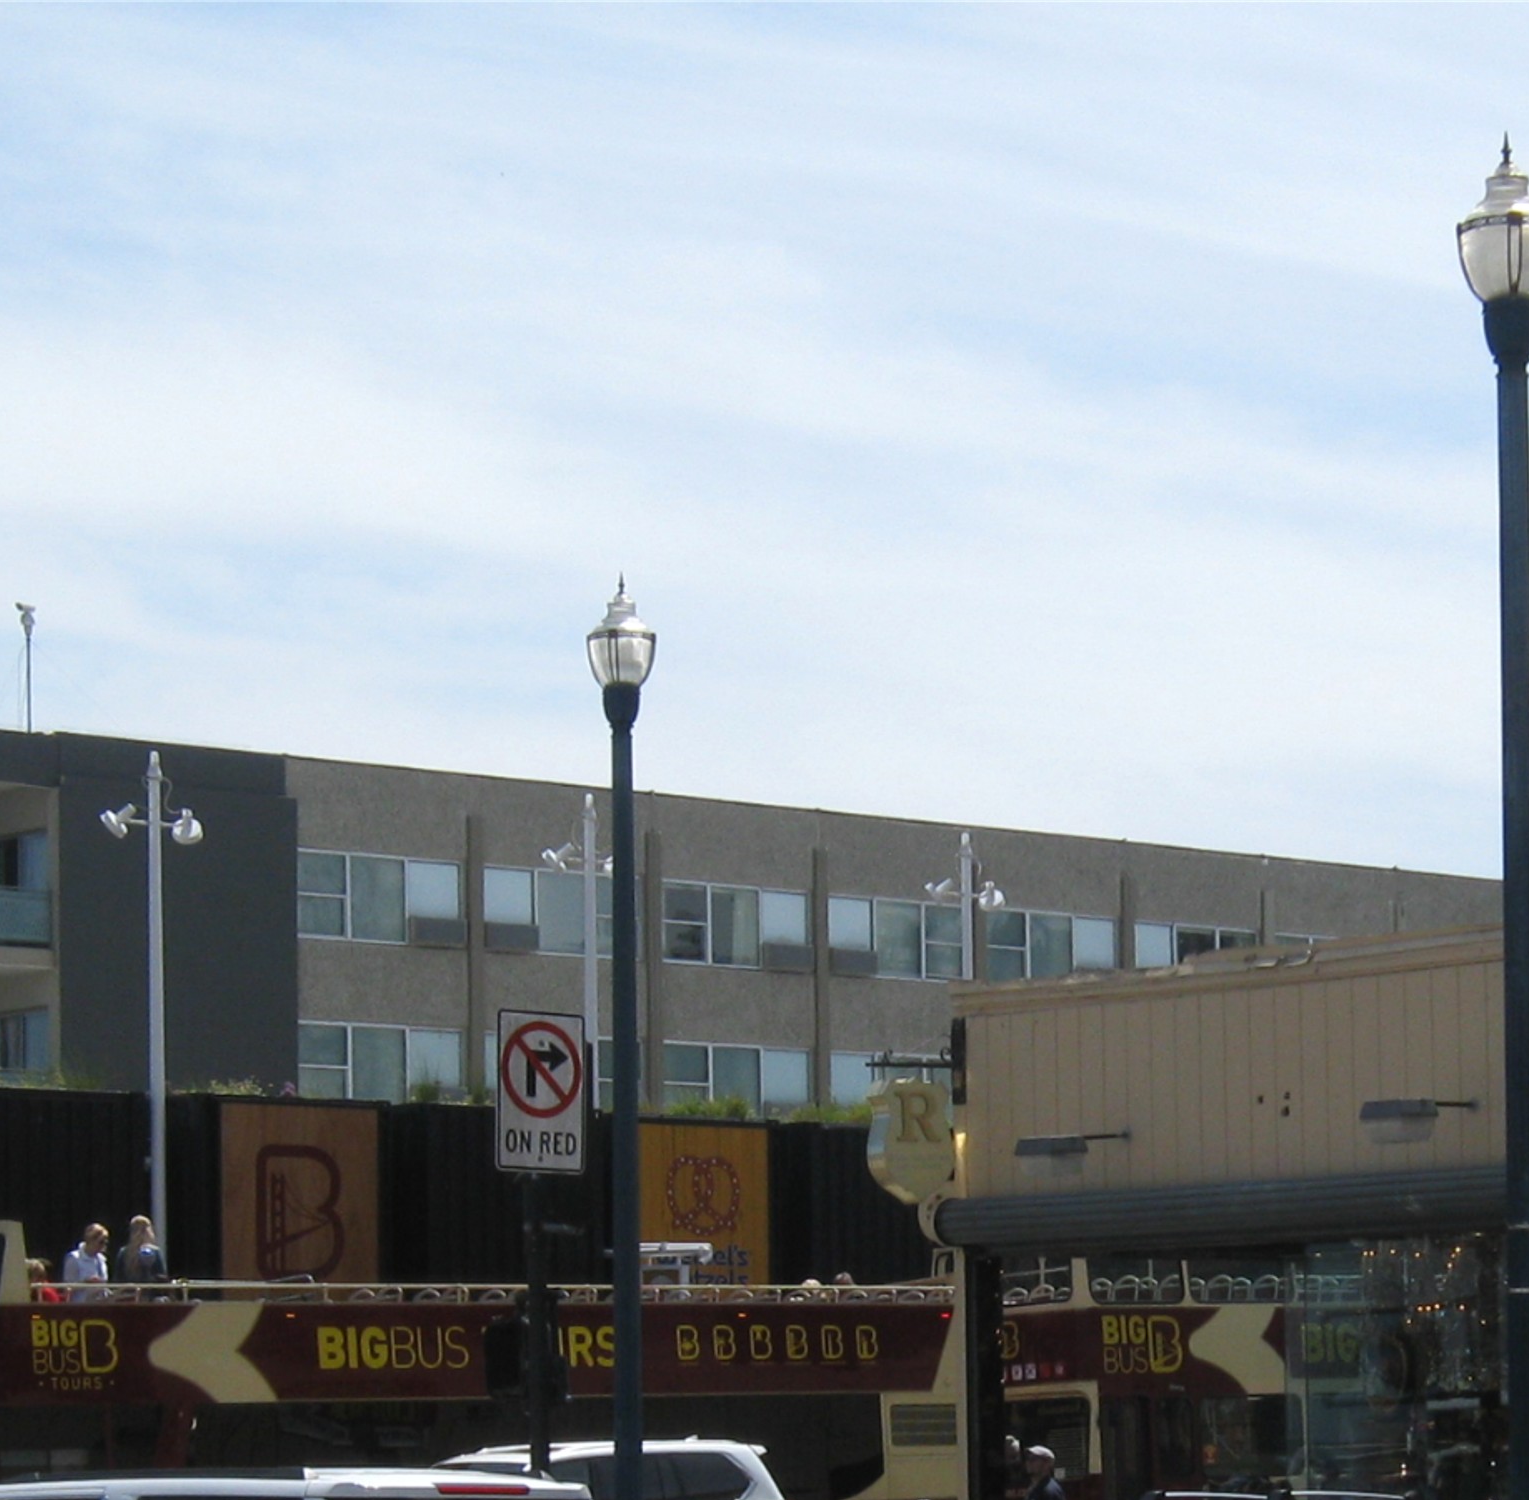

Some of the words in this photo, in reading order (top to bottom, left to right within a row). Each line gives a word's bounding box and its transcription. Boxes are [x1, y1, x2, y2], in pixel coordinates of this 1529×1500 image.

[894, 1091, 941, 1142] R
[506, 1129, 531, 1153] ON
[540, 1130, 577, 1155] RED
[31, 1319, 78, 1347] BIG
[1101, 1315, 1147, 1345] BIG
[1302, 1322, 1358, 1362] BIG
[32, 1348, 80, 1375] BUS
[1103, 1346, 1149, 1374] BUS
[50, 1376, 103, 1391] TOURS
